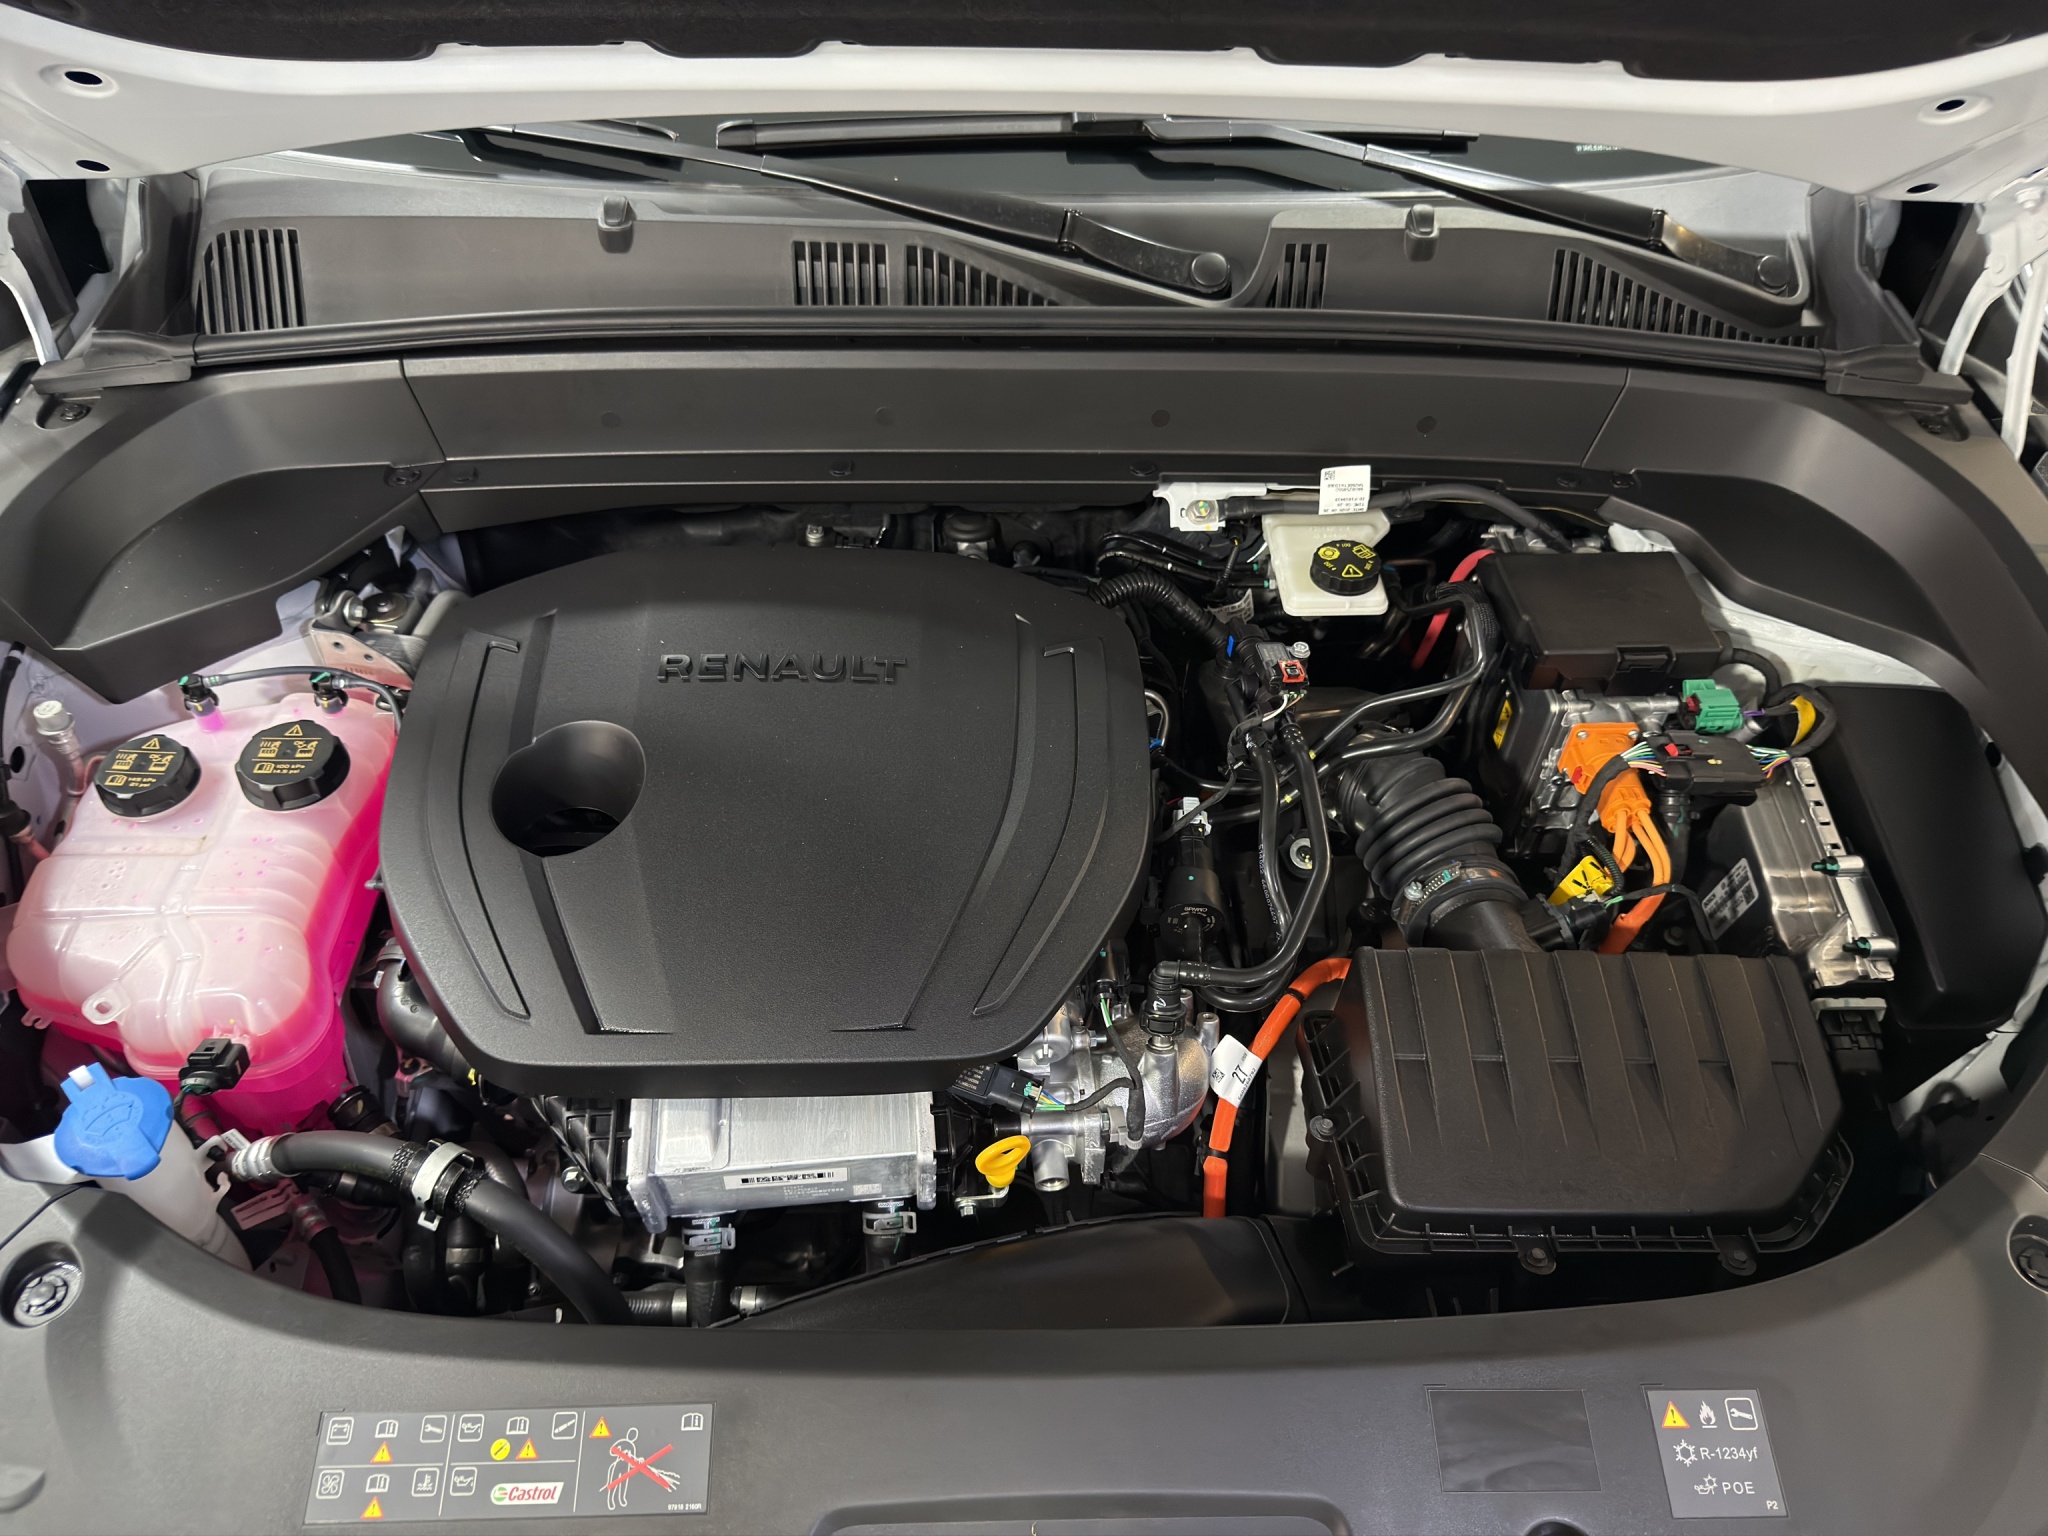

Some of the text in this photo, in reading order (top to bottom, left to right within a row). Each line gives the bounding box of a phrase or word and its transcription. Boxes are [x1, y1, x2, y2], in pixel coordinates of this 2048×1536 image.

[657, 653, 907, 683] RENAULT
[1232, 1064, 1248, 1084] 27
[1700, 1446, 1758, 1462] R-1234yf
[508, 1486, 557, 1501] Castrol
[1722, 1482, 1755, 1495] POE
[1766, 1500, 1779, 1510] P2
